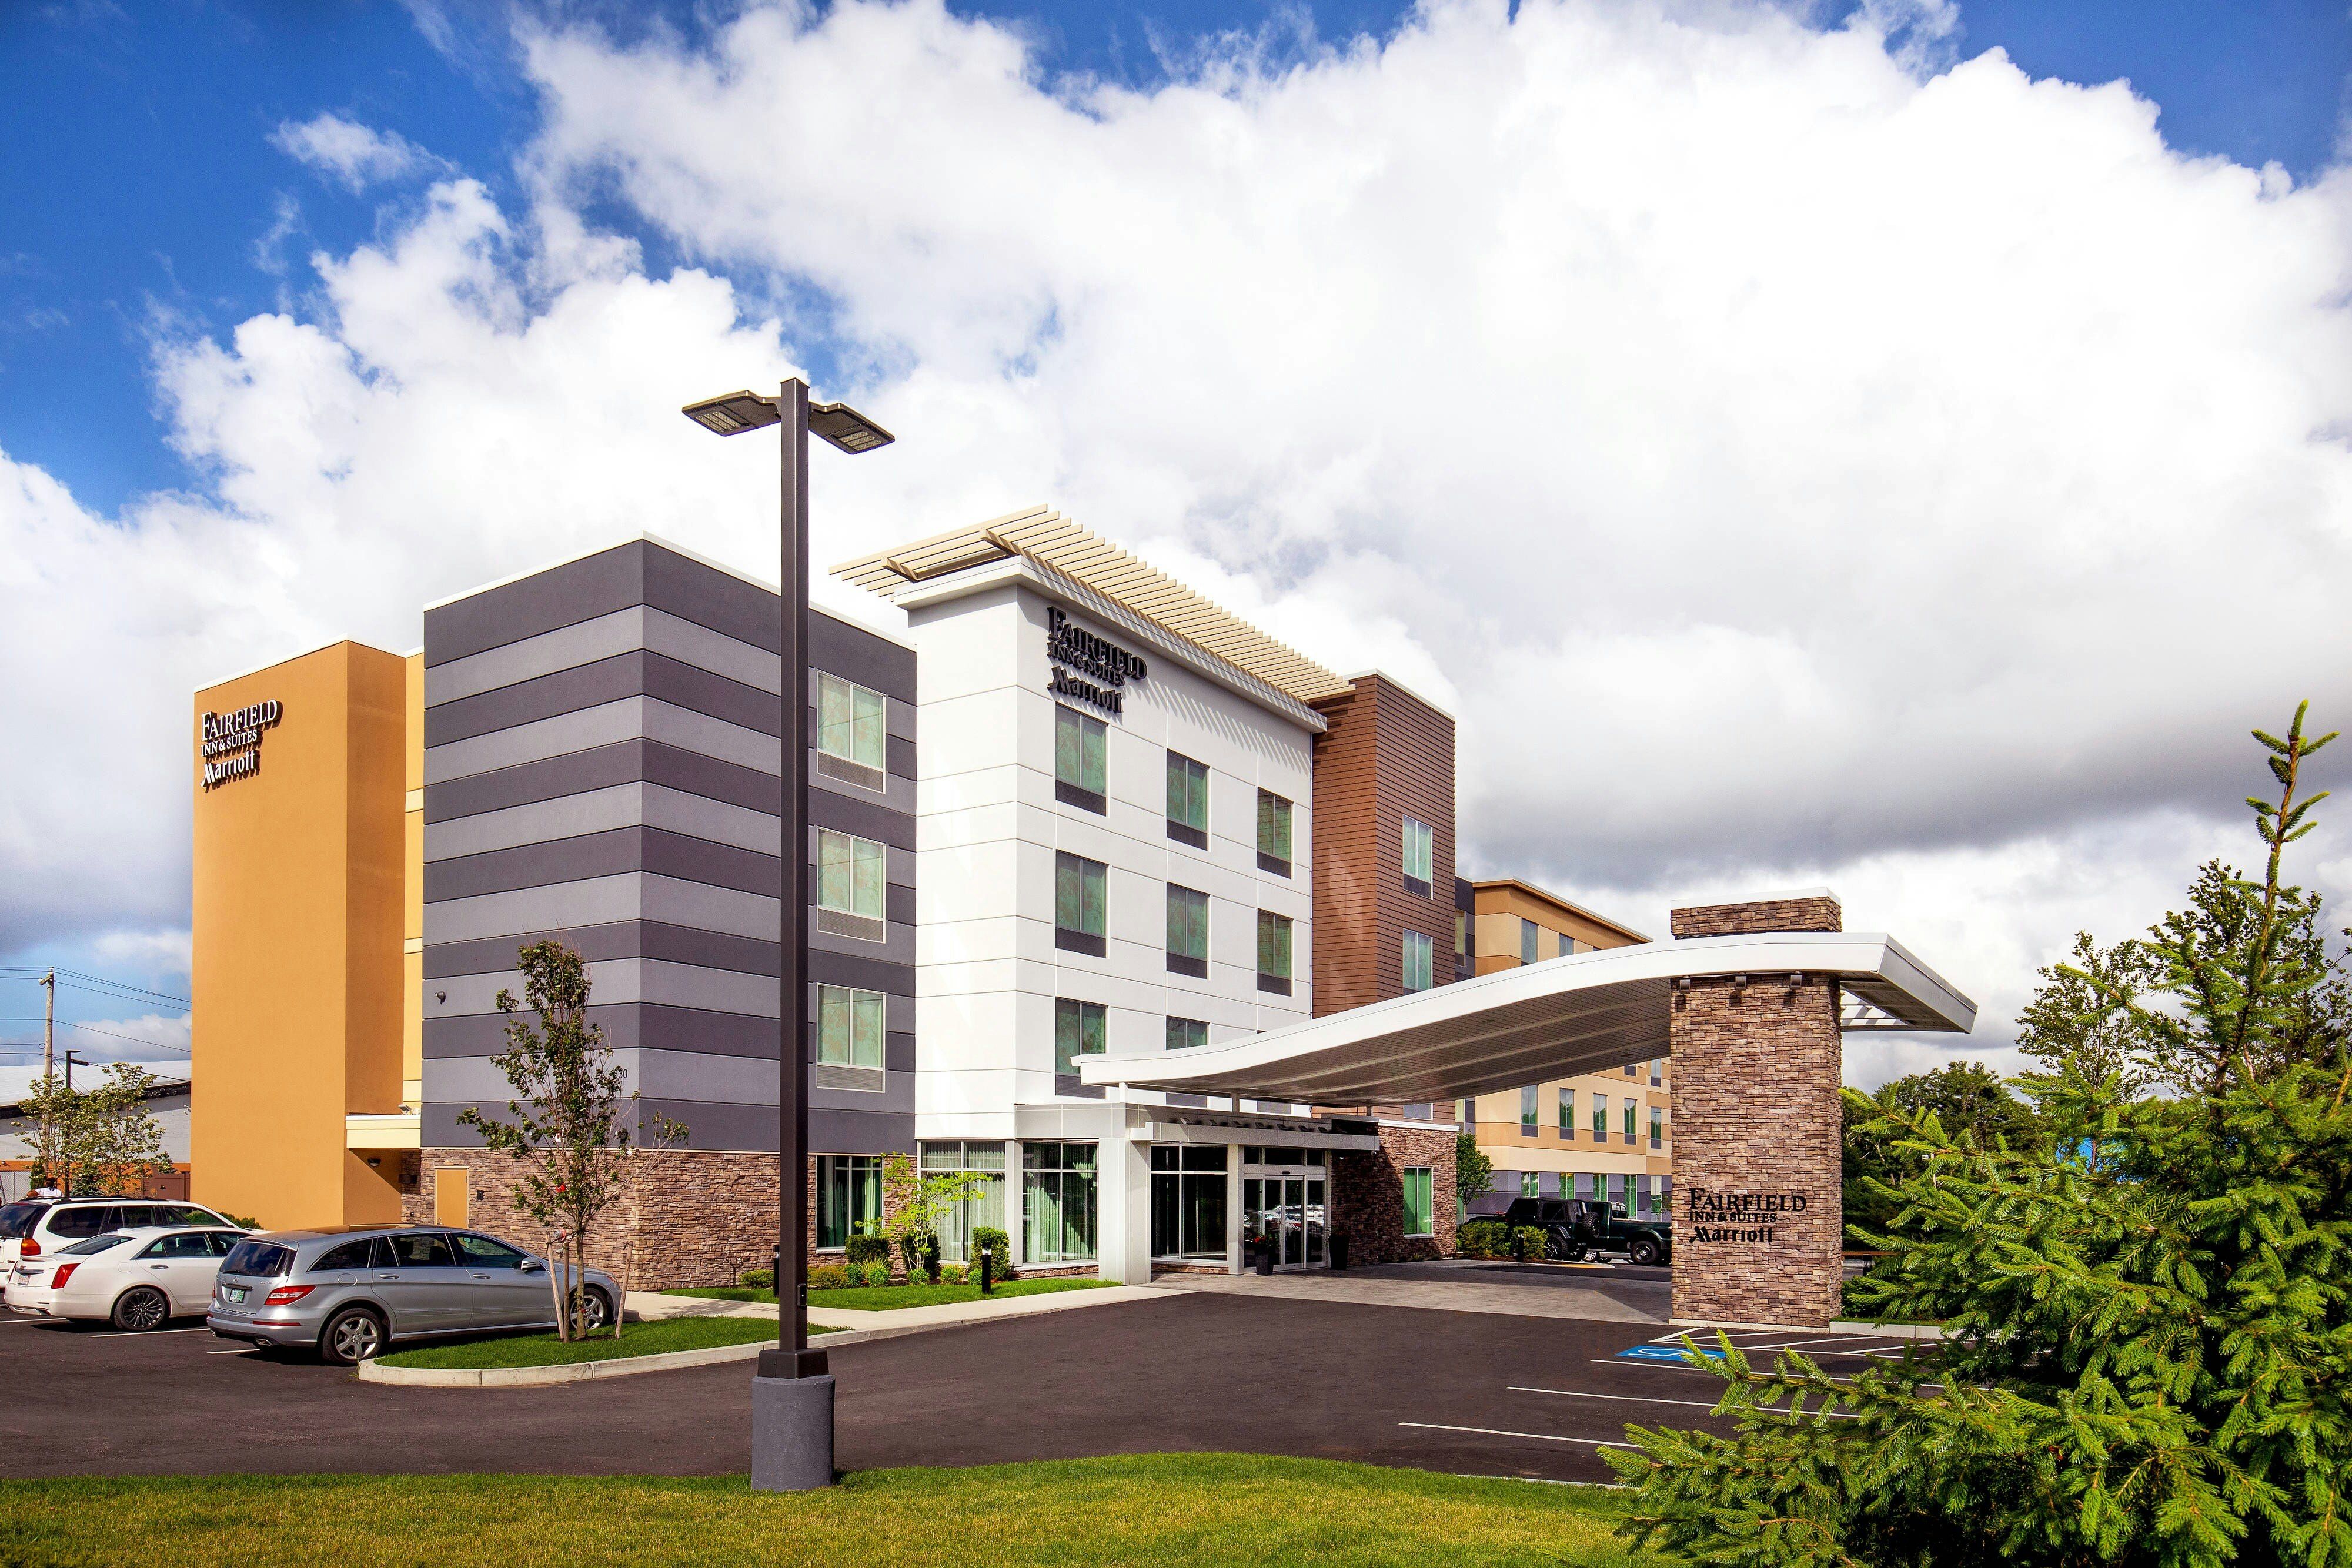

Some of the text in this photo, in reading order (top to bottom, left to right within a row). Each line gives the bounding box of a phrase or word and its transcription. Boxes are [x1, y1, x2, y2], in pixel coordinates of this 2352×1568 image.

[1047, 606, 1148, 680] FAIRFIELD
[1047, 641, 1075, 664] INN
[1085, 658, 1125, 687] SUITES
[1047, 666, 1122, 713] Marriott
[201, 699, 279, 741] FAIRFIELD
[201, 729, 258, 757] INN & SUITES
[201, 750, 256, 787] Marriott
[1689, 1188, 1807, 1212] FAIRFIELD
[1689, 1211, 1777, 1222] INN & SUITES
[1689, 1225, 1774, 1243] Marriott
